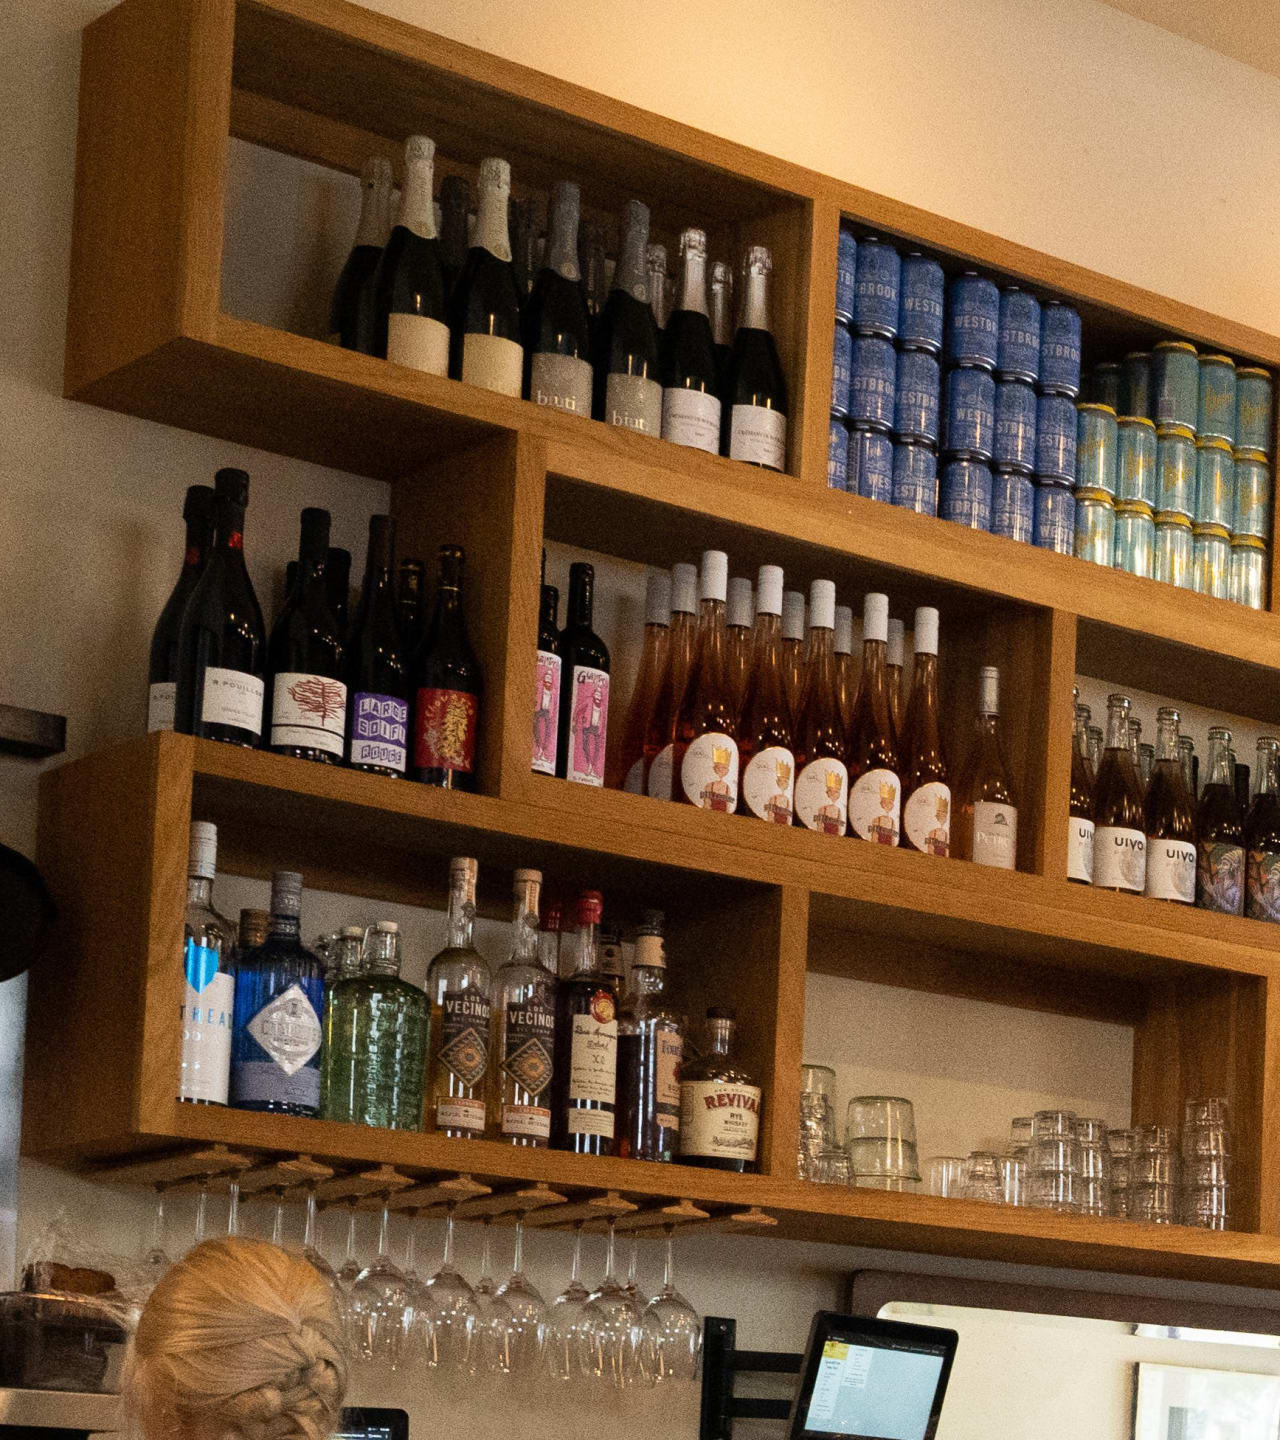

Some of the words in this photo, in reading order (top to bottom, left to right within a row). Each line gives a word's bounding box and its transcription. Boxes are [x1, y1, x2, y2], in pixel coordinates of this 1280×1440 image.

[360, 699, 407, 721] LARGE
[1114, 836, 1145, 851] UIVO
[1166, 848, 1194, 864] UIVO
[446, 1000, 490, 1019] VECINOS
